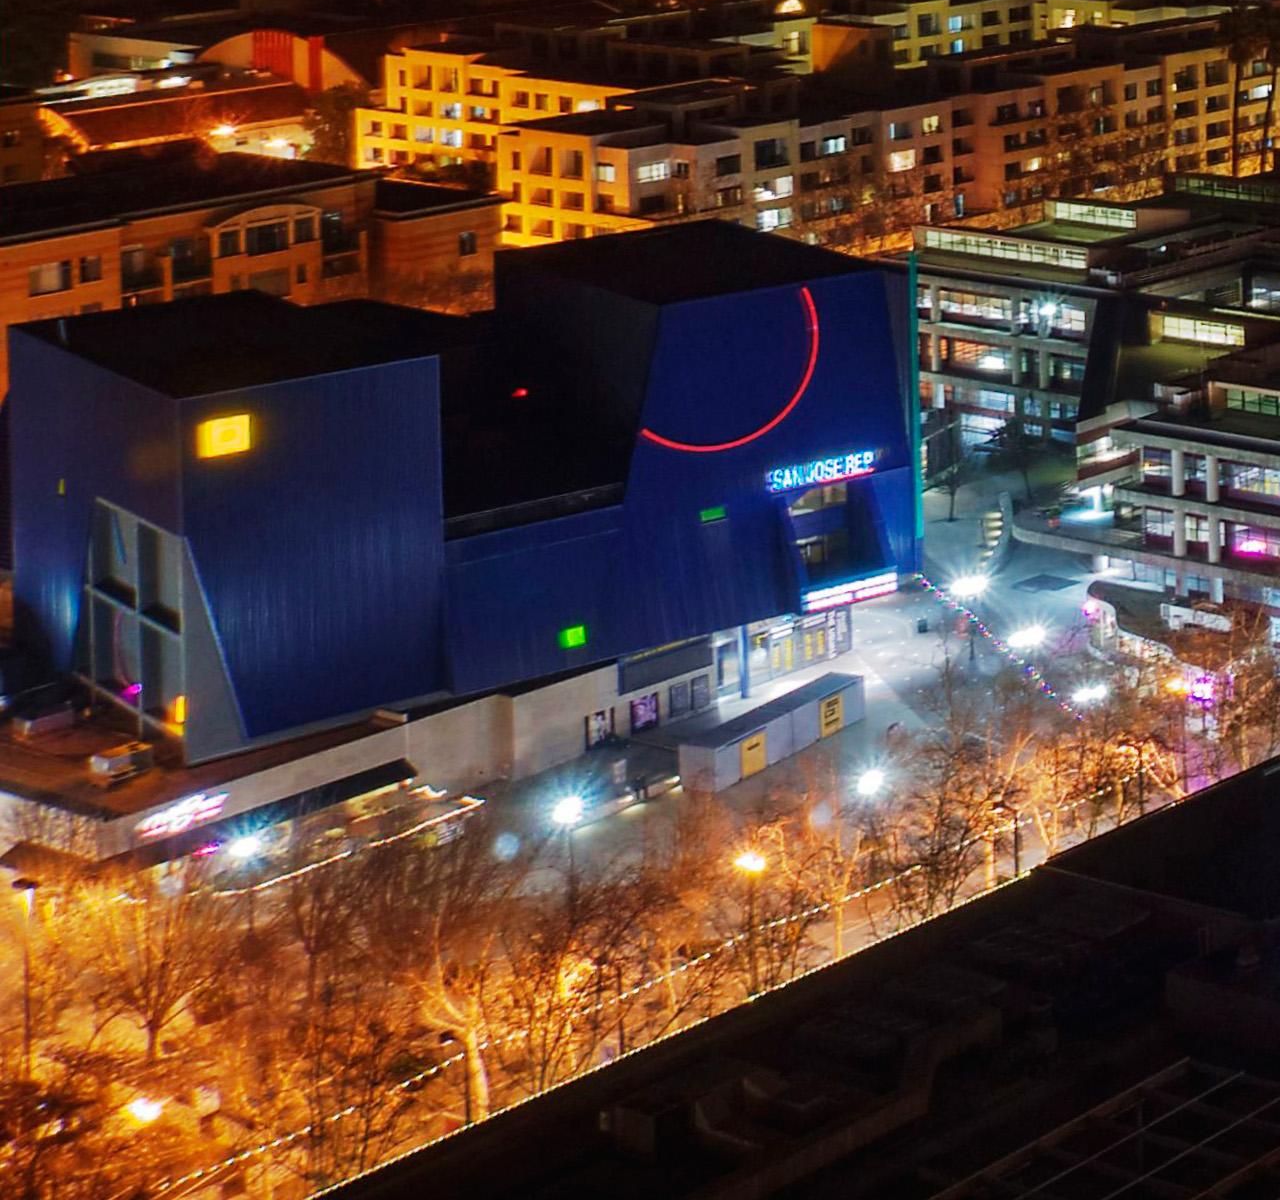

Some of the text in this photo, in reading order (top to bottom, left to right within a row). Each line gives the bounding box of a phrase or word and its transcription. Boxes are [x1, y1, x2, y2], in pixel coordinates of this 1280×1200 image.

[770, 451, 874, 492] SAN JOSE REP
